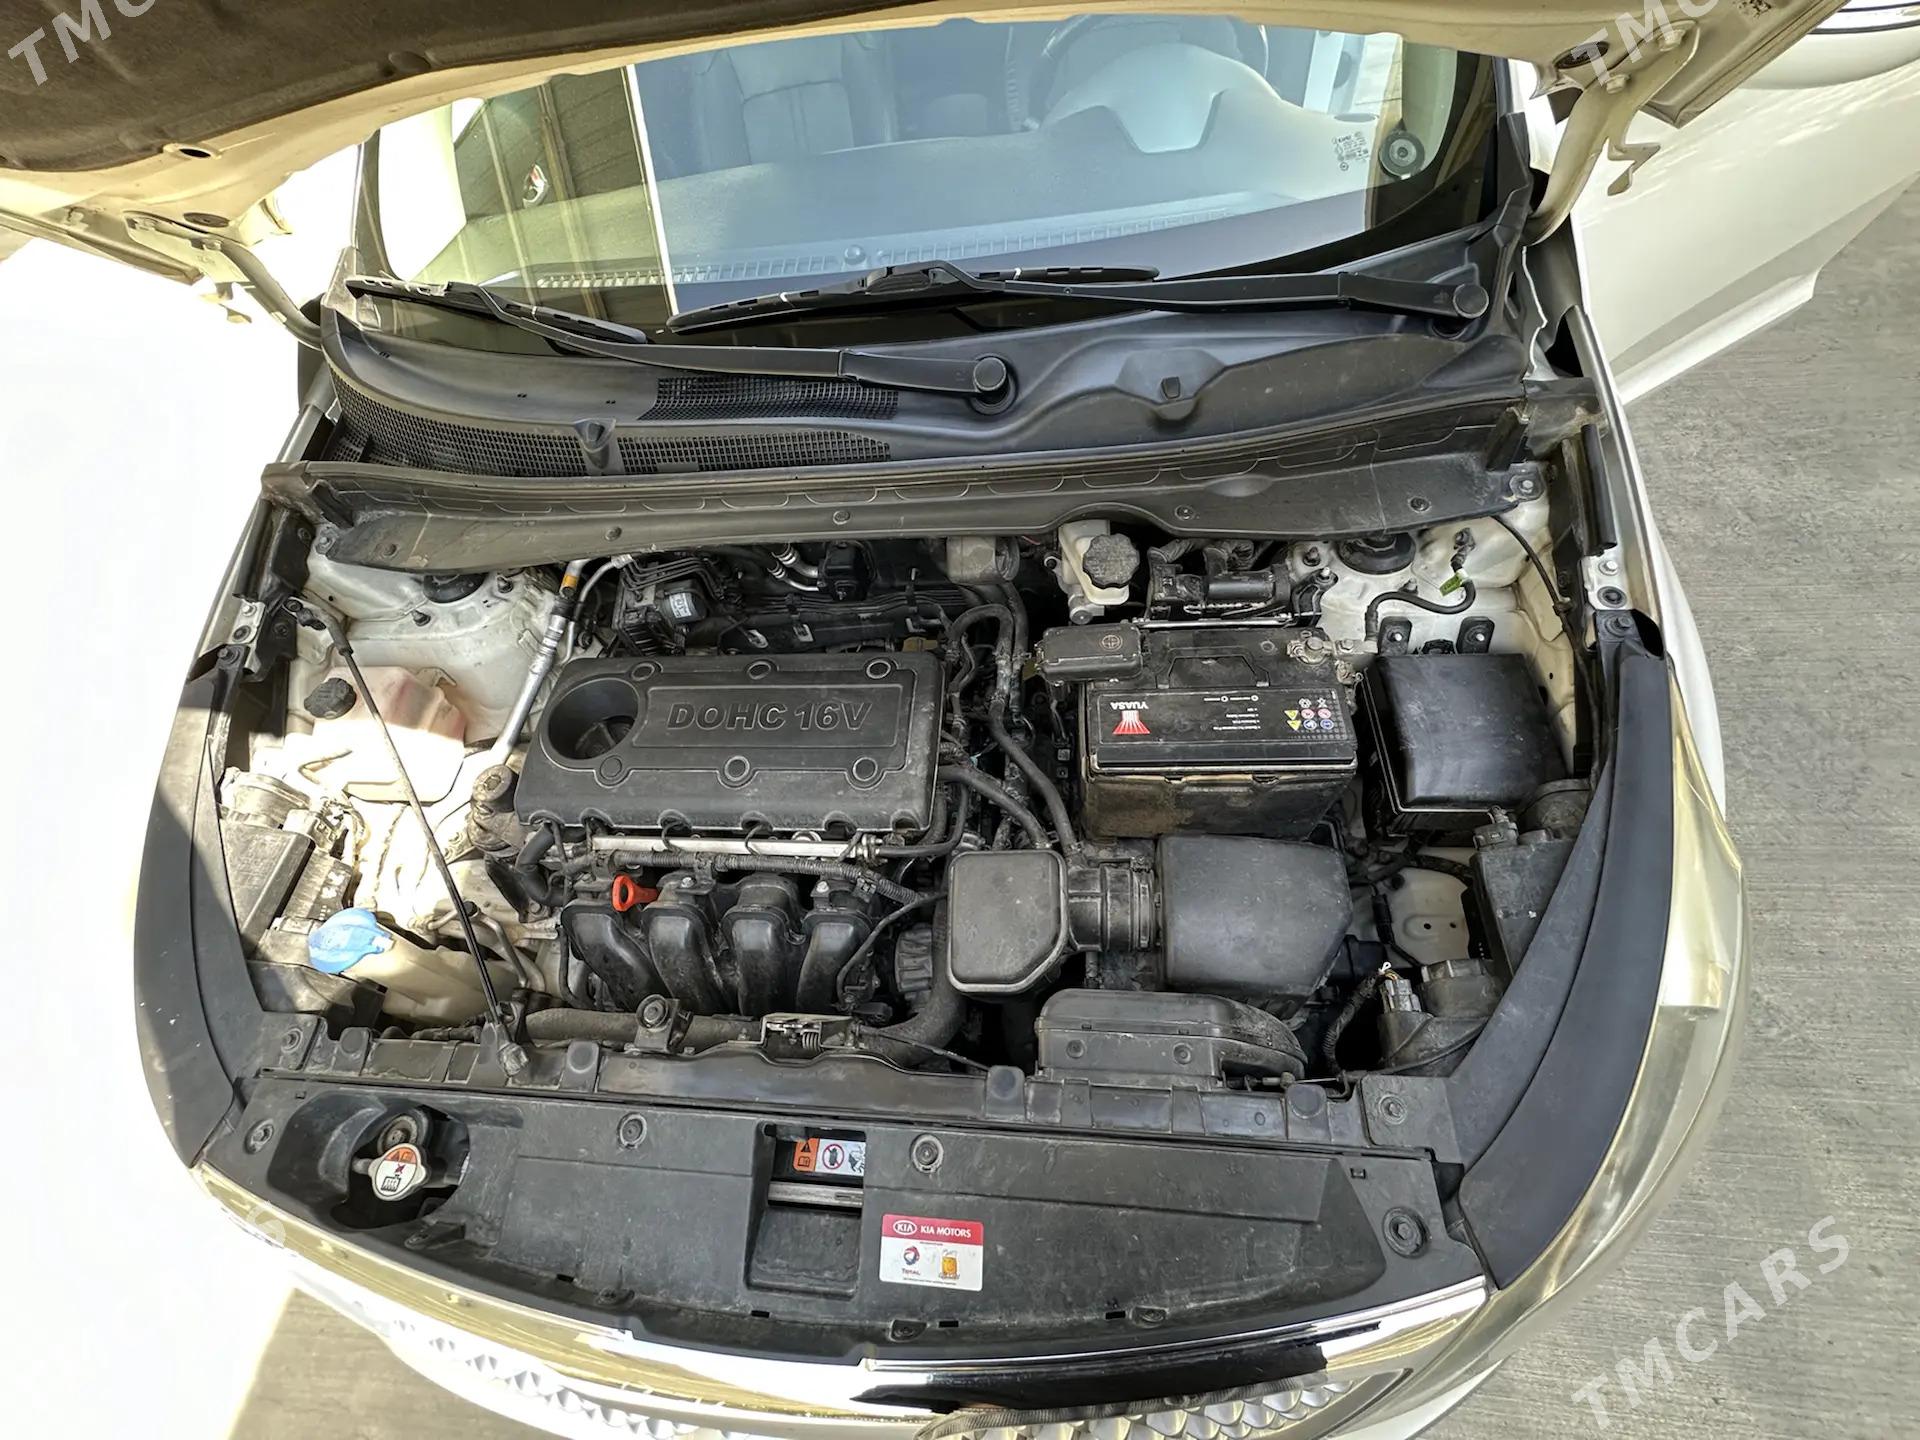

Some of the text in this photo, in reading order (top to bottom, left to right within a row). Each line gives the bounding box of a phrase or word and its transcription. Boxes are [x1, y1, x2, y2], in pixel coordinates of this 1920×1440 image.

[1110, 701, 1149, 710] YUASA
[667, 702, 873, 731] DOHC 16V
[895, 1221, 915, 1233] KIA
[920, 1225, 972, 1238] KIA MOTORS
